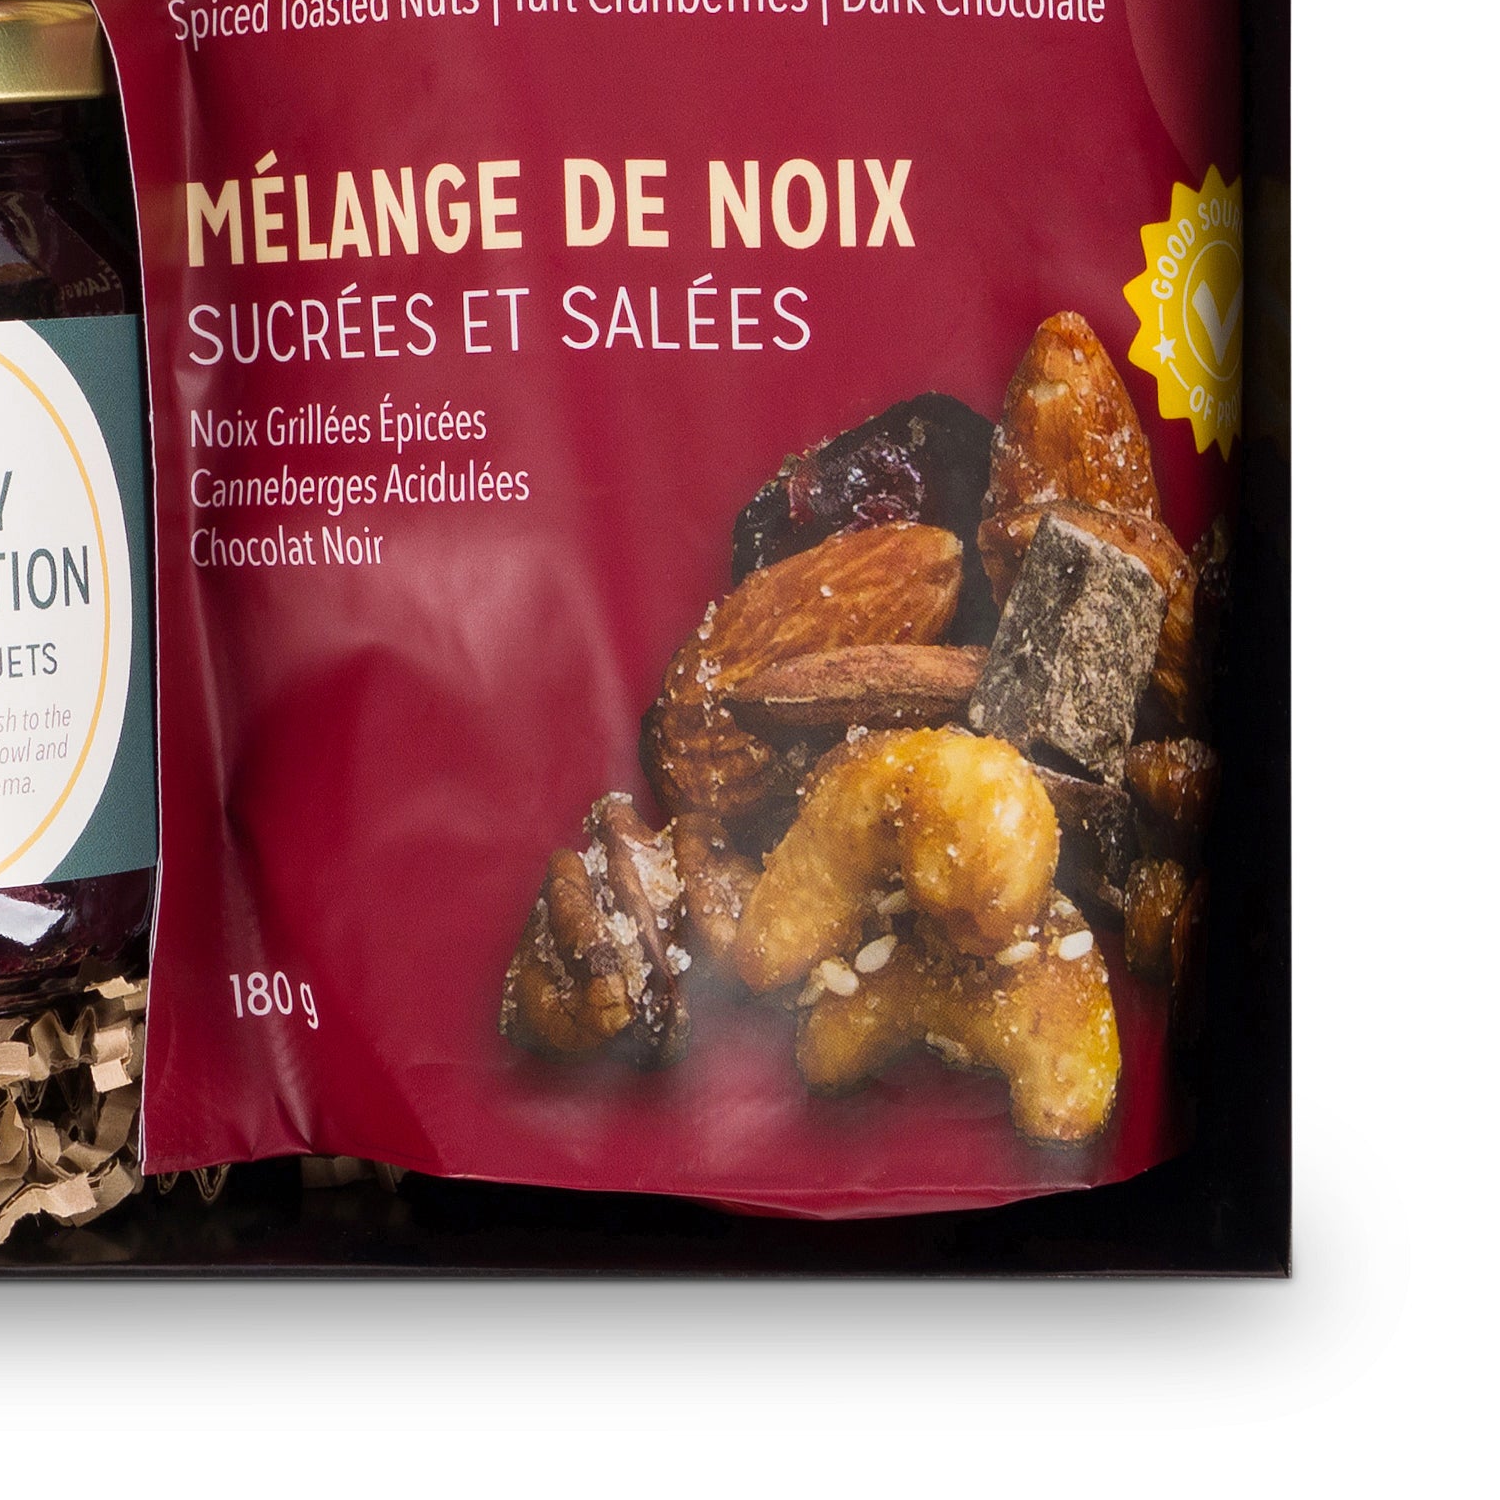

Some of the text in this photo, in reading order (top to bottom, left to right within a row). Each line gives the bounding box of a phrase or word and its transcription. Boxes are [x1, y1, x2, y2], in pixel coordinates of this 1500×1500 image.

[187, 150, 915, 267] MÉLANGE DE NOIX
[1151, 218, 1197, 300] GOOD
[189, 273, 810, 365] SUCRÉES ET SALÉES
[191, 393, 486, 451] Noix Grillées Épicées
[1190, 384, 1241, 429] OF PRO
[191, 460, 529, 516] Canneberges Acidulées
[191, 525, 383, 566] Chocolat Noir
[23, 710, 40, 731] to
[45, 704, 71, 729] the
[36, 734, 68, 761] and
[230, 971, 318, 1029] 180 g
